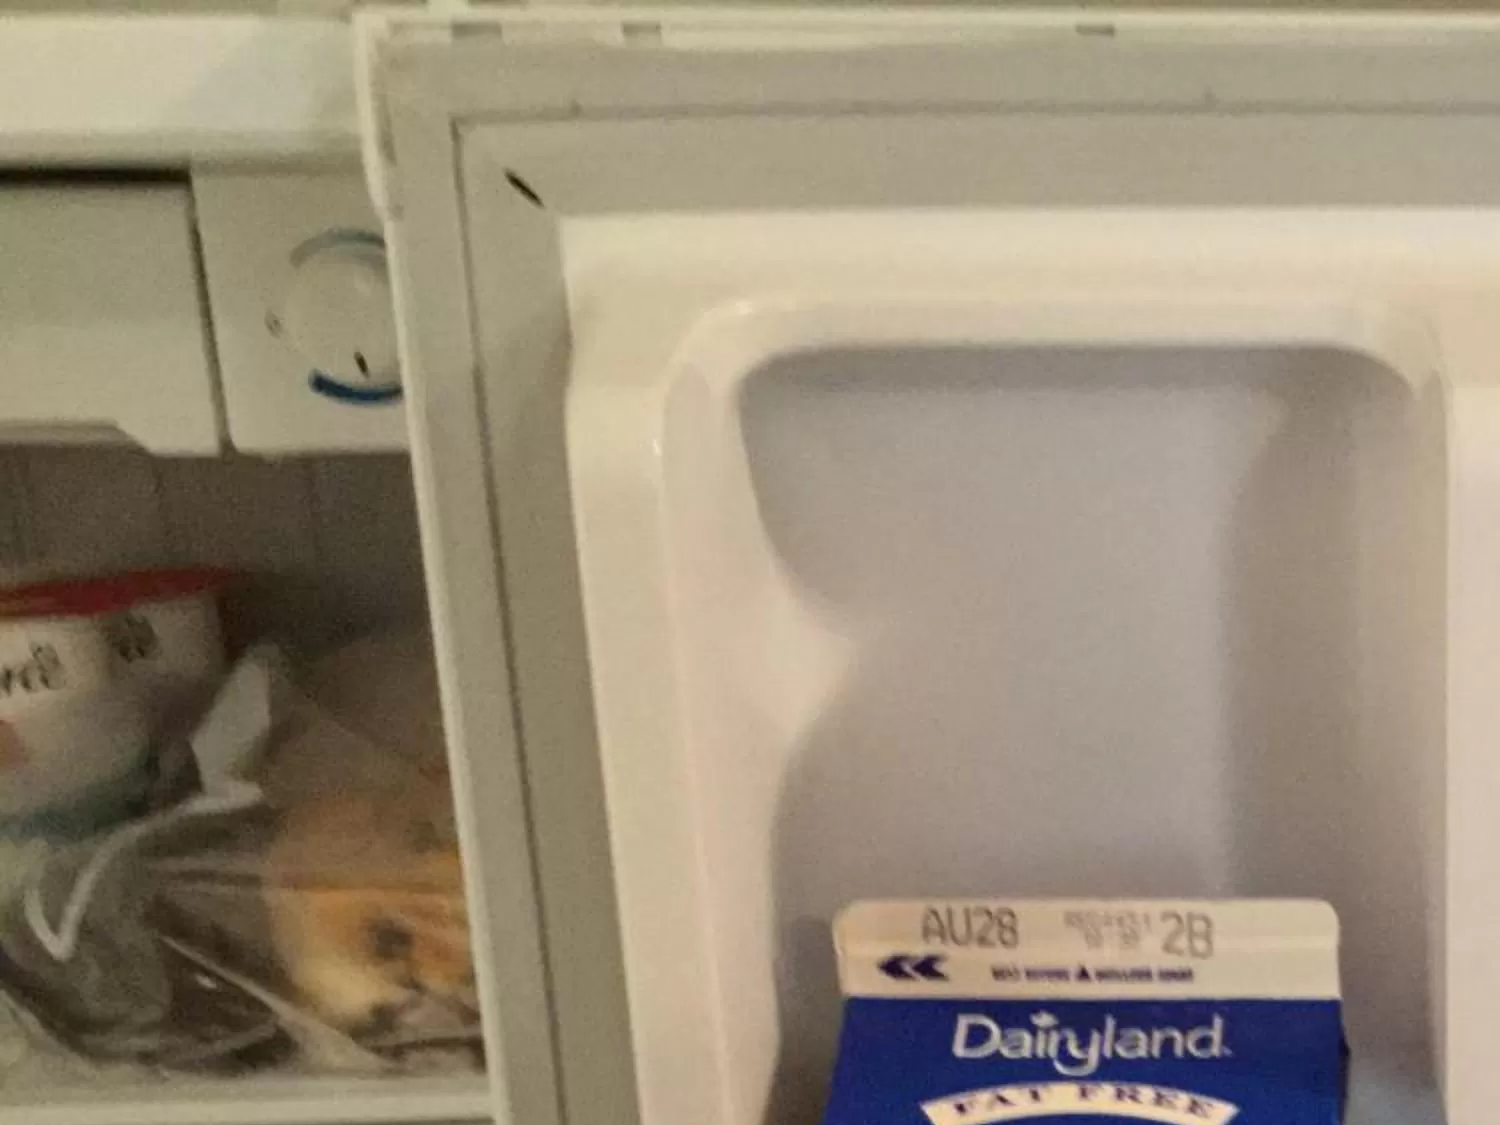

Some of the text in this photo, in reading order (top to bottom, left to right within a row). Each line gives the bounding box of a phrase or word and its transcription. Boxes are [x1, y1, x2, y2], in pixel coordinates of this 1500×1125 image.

[921, 905, 1019, 949] AU28
[1159, 909, 1215, 960] 2B
[952, 1011, 1228, 1077] Dairyland
[952, 1083, 1217, 1119] FAT FREE
